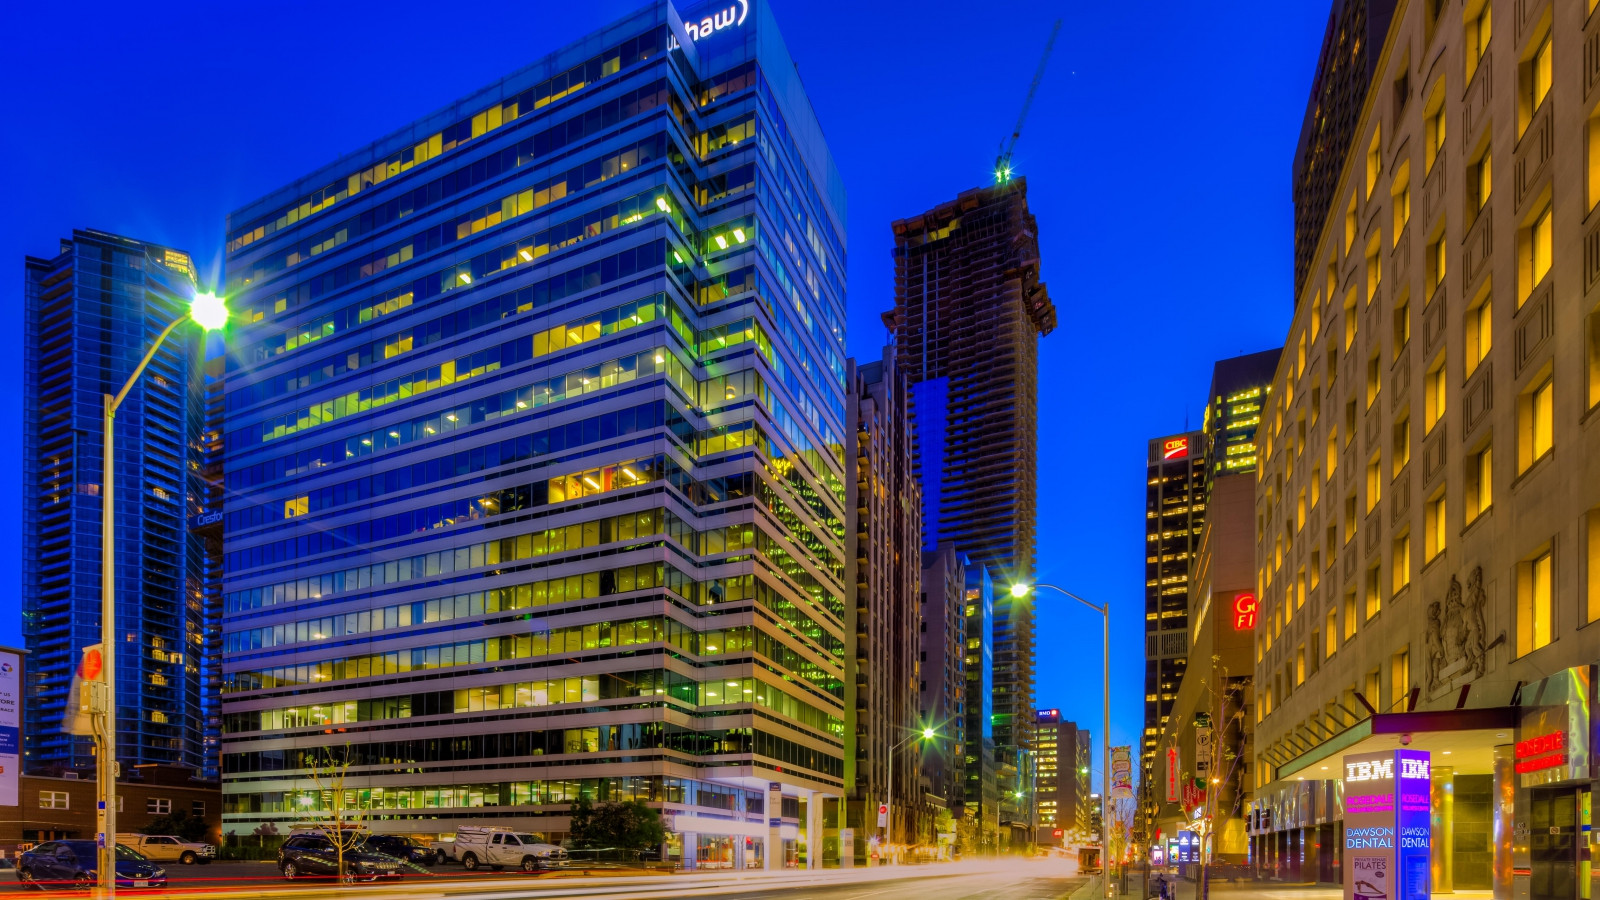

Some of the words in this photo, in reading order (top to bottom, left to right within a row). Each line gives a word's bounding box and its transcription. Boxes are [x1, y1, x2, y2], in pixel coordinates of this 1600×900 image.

[684, 6, 736, 41] haw
[1165, 439, 1186, 450] CIBC
[1346, 759, 1393, 782] IBM
[1401, 758, 1429, 779] IBM
[1346, 794, 1393, 805] ROSEDALE
[1346, 827, 1394, 837] DAWSON
[1401, 827, 1430, 836] DAWSON
[1346, 837, 1394, 849] DENTAL
[1401, 837, 1430, 848] DENTAL
[1354, 861, 1386, 869] PILATES
